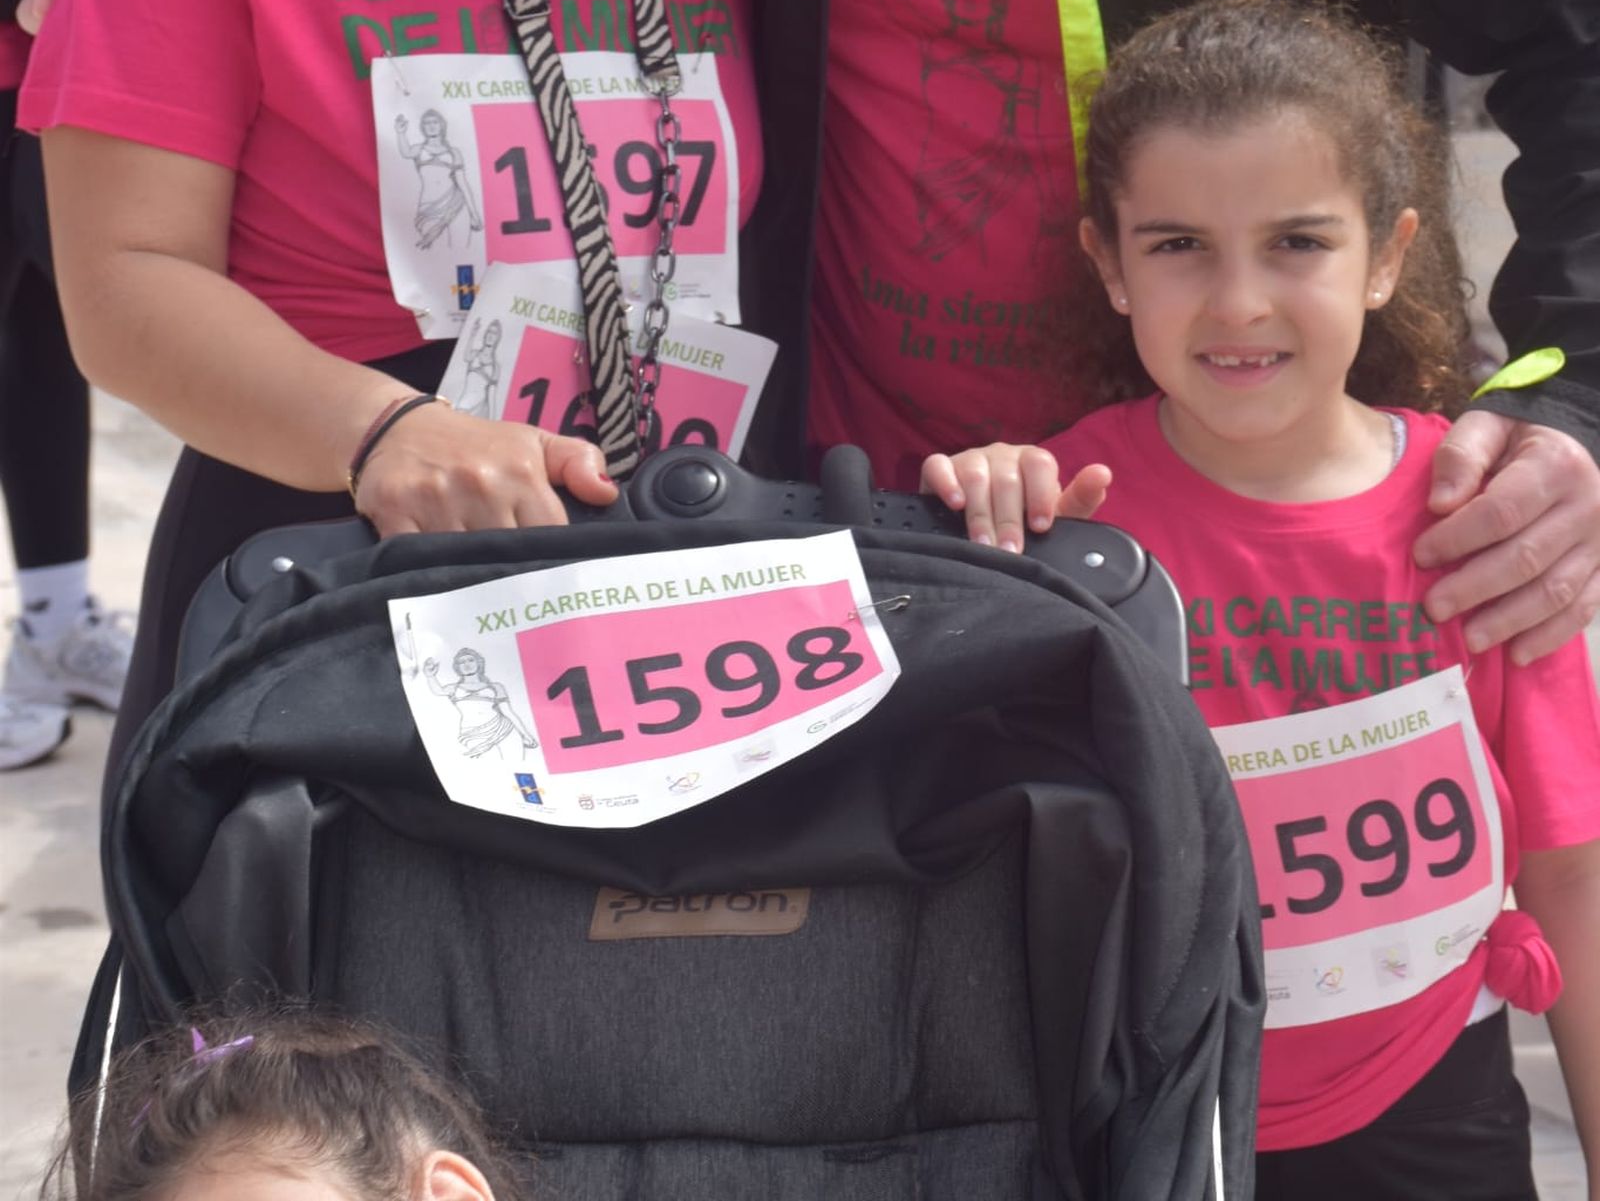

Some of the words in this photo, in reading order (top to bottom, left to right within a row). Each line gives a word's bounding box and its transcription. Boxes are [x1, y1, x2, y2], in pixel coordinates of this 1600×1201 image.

[442, 80, 471, 99] XXI
[476, 79, 532, 97] CARR
[571, 78, 594, 95] DE
[601, 77, 625, 94] LA
[494, 140, 717, 236] 197
[509, 296, 536, 316] XXI
[536, 303, 585, 334] CARRE
[660, 338, 726, 370] MUJER
[476, 611, 517, 635] XXI
[524, 585, 640, 622] CARRERA
[646, 580, 679, 602] DE
[685, 575, 714, 597] LA
[721, 563, 807, 592] MUJER
[546, 626, 864, 749] 1598
[1227, 748, 1288, 774] RERA
[1293, 740, 1323, 763] DE
[1328, 731, 1357, 755] LA
[1360, 710, 1431, 748] MUJER
[1260, 777, 1477, 922] 599
